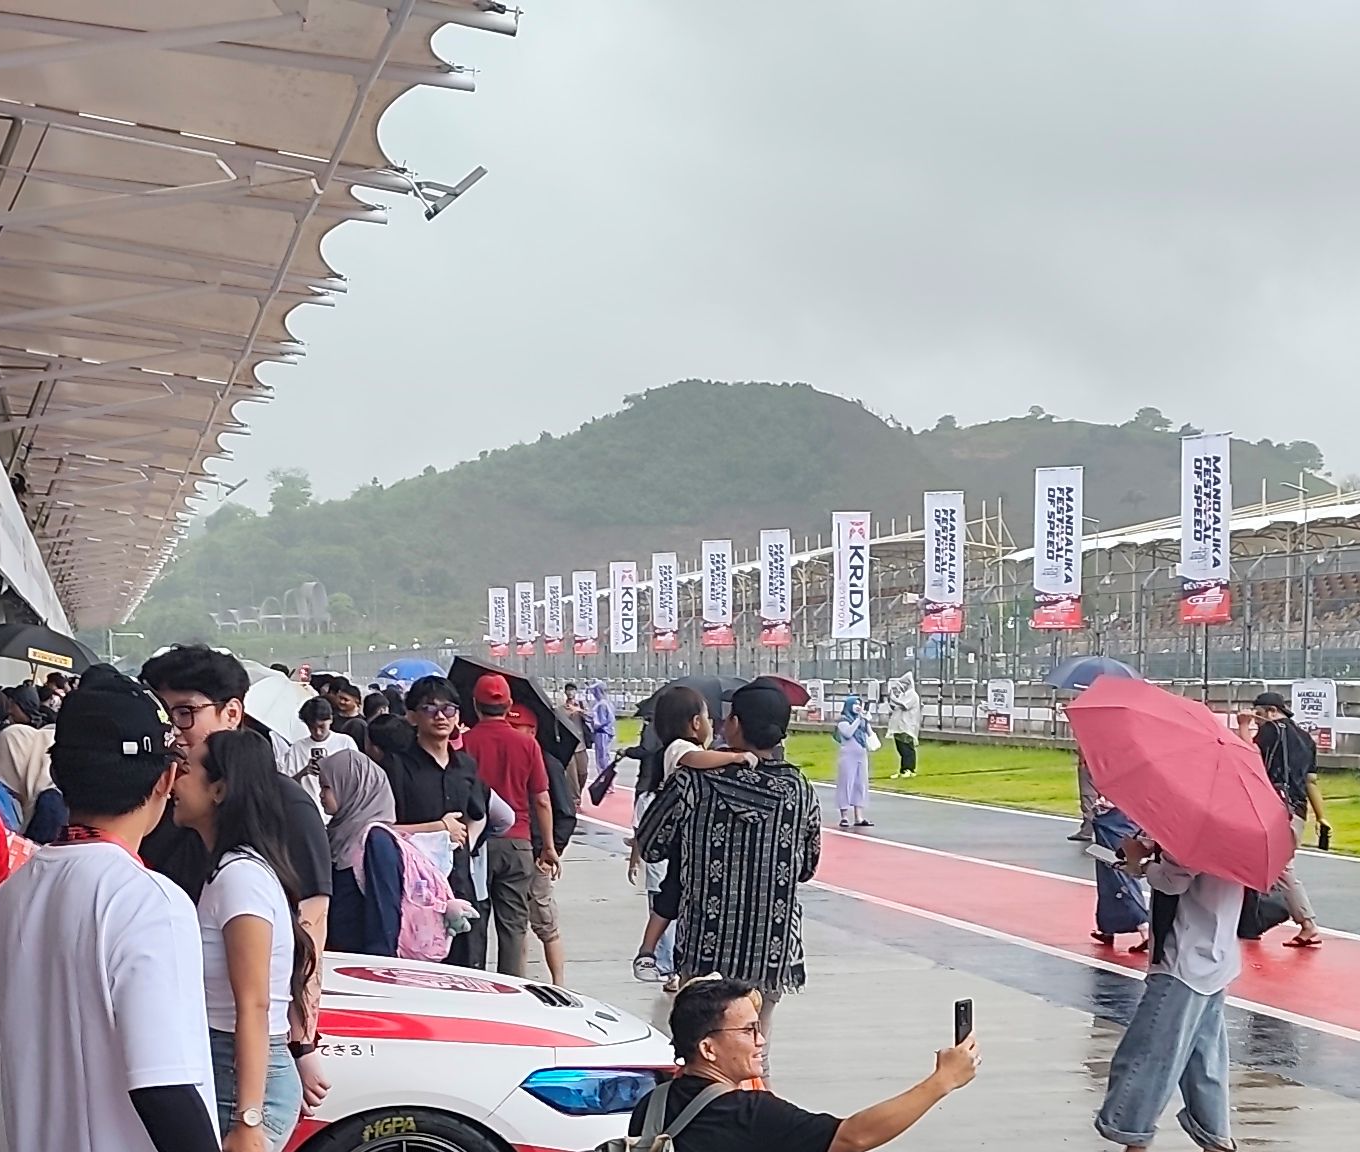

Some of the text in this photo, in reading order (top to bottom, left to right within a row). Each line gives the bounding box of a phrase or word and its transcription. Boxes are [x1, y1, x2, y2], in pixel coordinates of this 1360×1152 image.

[1047, 488, 1056, 560] OF SPEED
[1064, 486, 1074, 584] MANDALIKA
[1194, 458, 1202, 542] OF SPEED
[1212, 455, 1222, 569] MANDALIKA
[849, 545, 865, 628] KRIDA
[948, 508, 956, 594] MANDALIKA
[621, 586, 634, 644] KRIDA
[362, 1116, 417, 1142] MGPA
